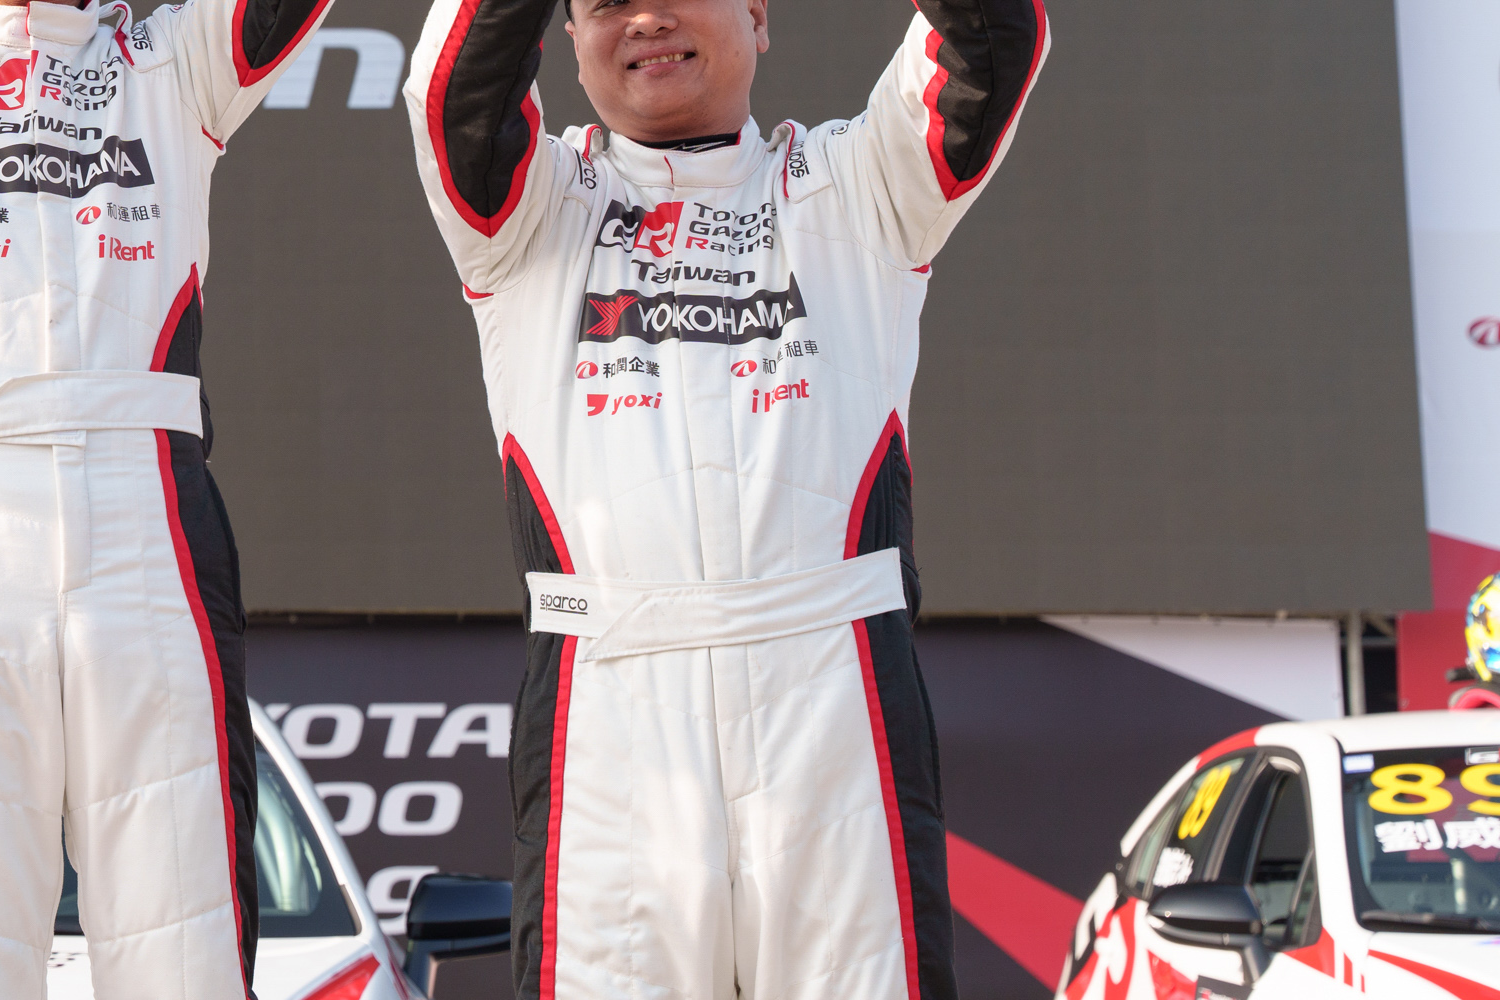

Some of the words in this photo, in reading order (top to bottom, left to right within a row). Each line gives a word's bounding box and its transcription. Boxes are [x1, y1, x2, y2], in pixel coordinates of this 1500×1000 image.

[106, 202, 161, 223] 和運租車
[631, 259, 756, 286] Taiwan
[638, 299, 794, 336] YOKOHAM
[611, 392, 663, 415] yoxi
[539, 593, 588, 613] sparco
